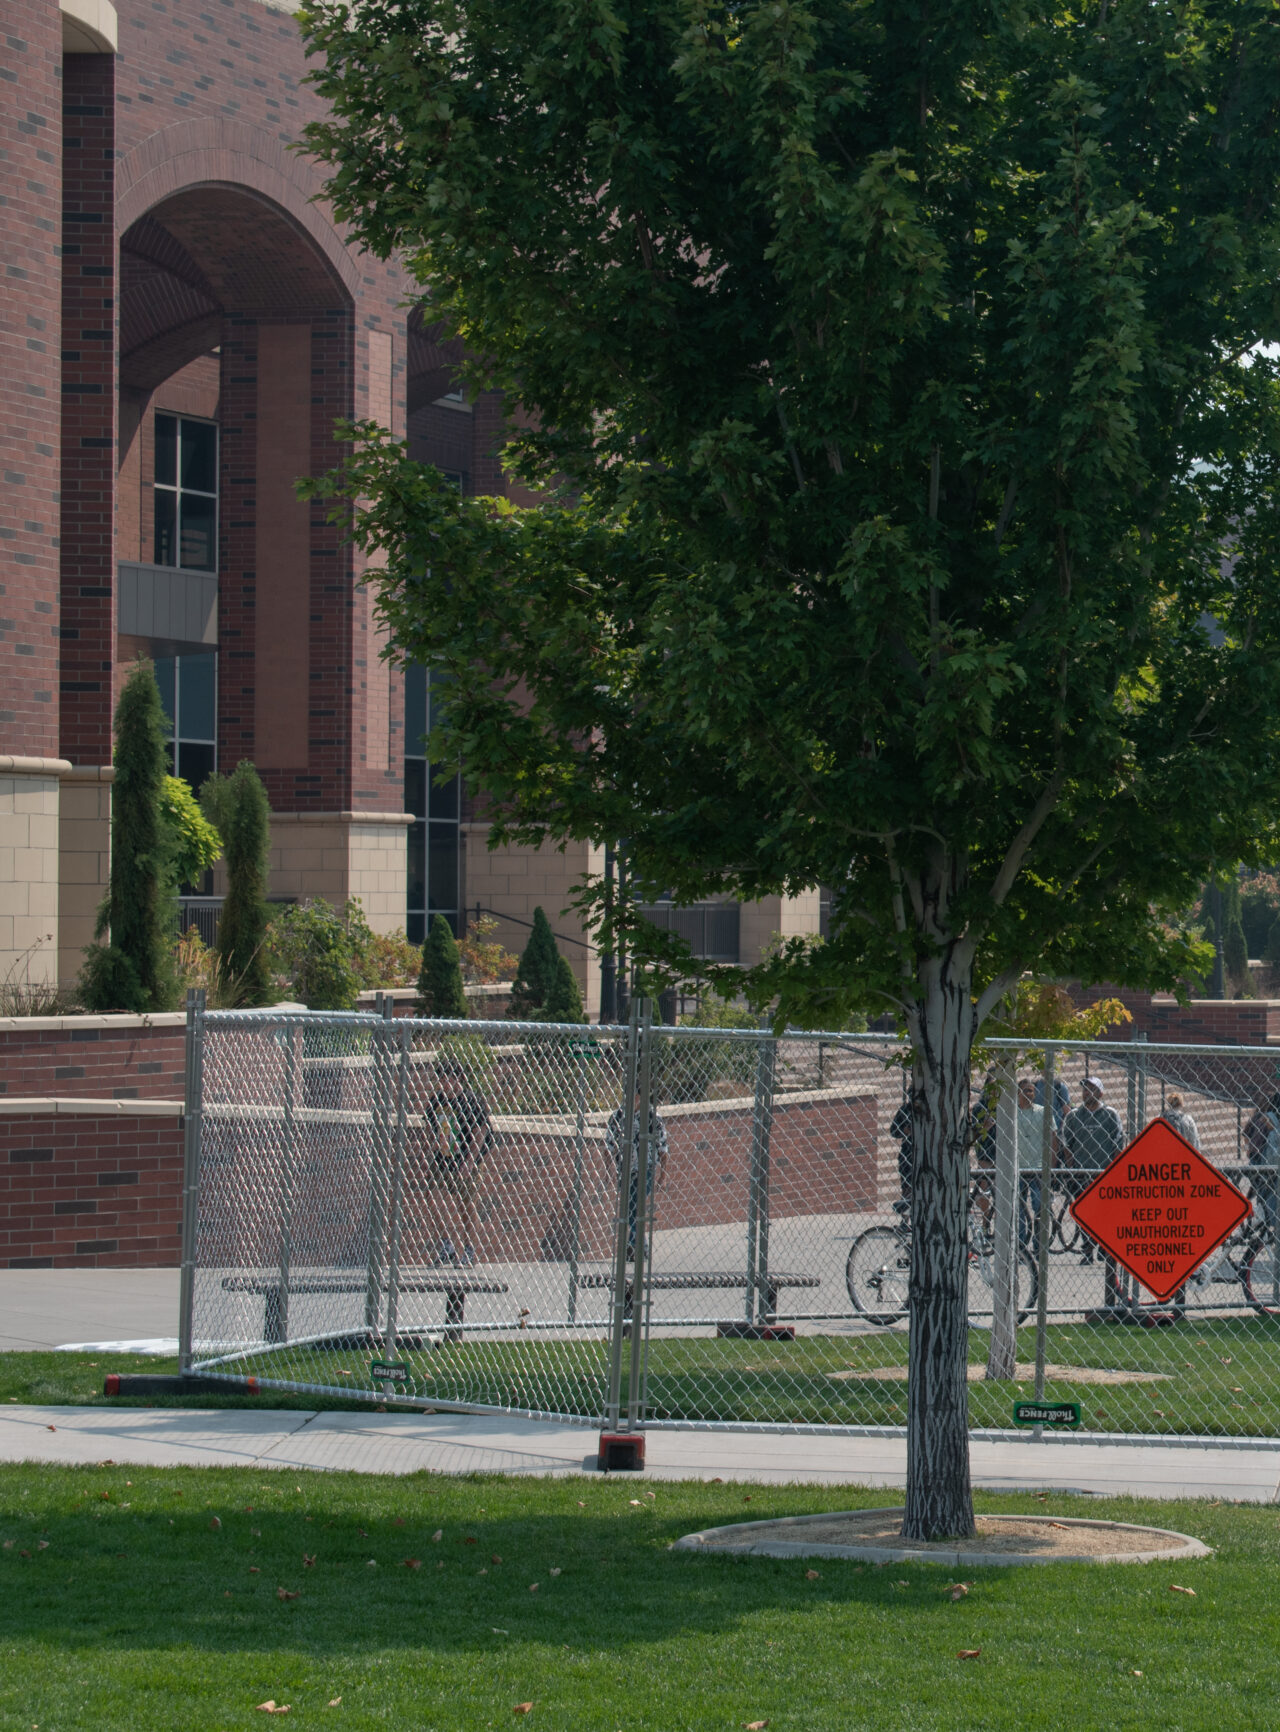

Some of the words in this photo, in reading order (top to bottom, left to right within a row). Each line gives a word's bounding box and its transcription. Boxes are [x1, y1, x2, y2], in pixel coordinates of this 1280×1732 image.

[1128, 1163, 1191, 1181] DANGER
[1099, 1185, 1185, 1200] CONSTRUCTION
[1190, 1184, 1221, 1198] ZONE
[1131, 1208, 1162, 1221] KEEP
[1166, 1207, 1188, 1220] OUT
[1116, 1225, 1205, 1239] UNAUTHORIZED
[1126, 1242, 1195, 1256] PERSONNEL
[1147, 1260, 1175, 1274] ONLY
[1019, 1409, 1047, 1418] FENCE
